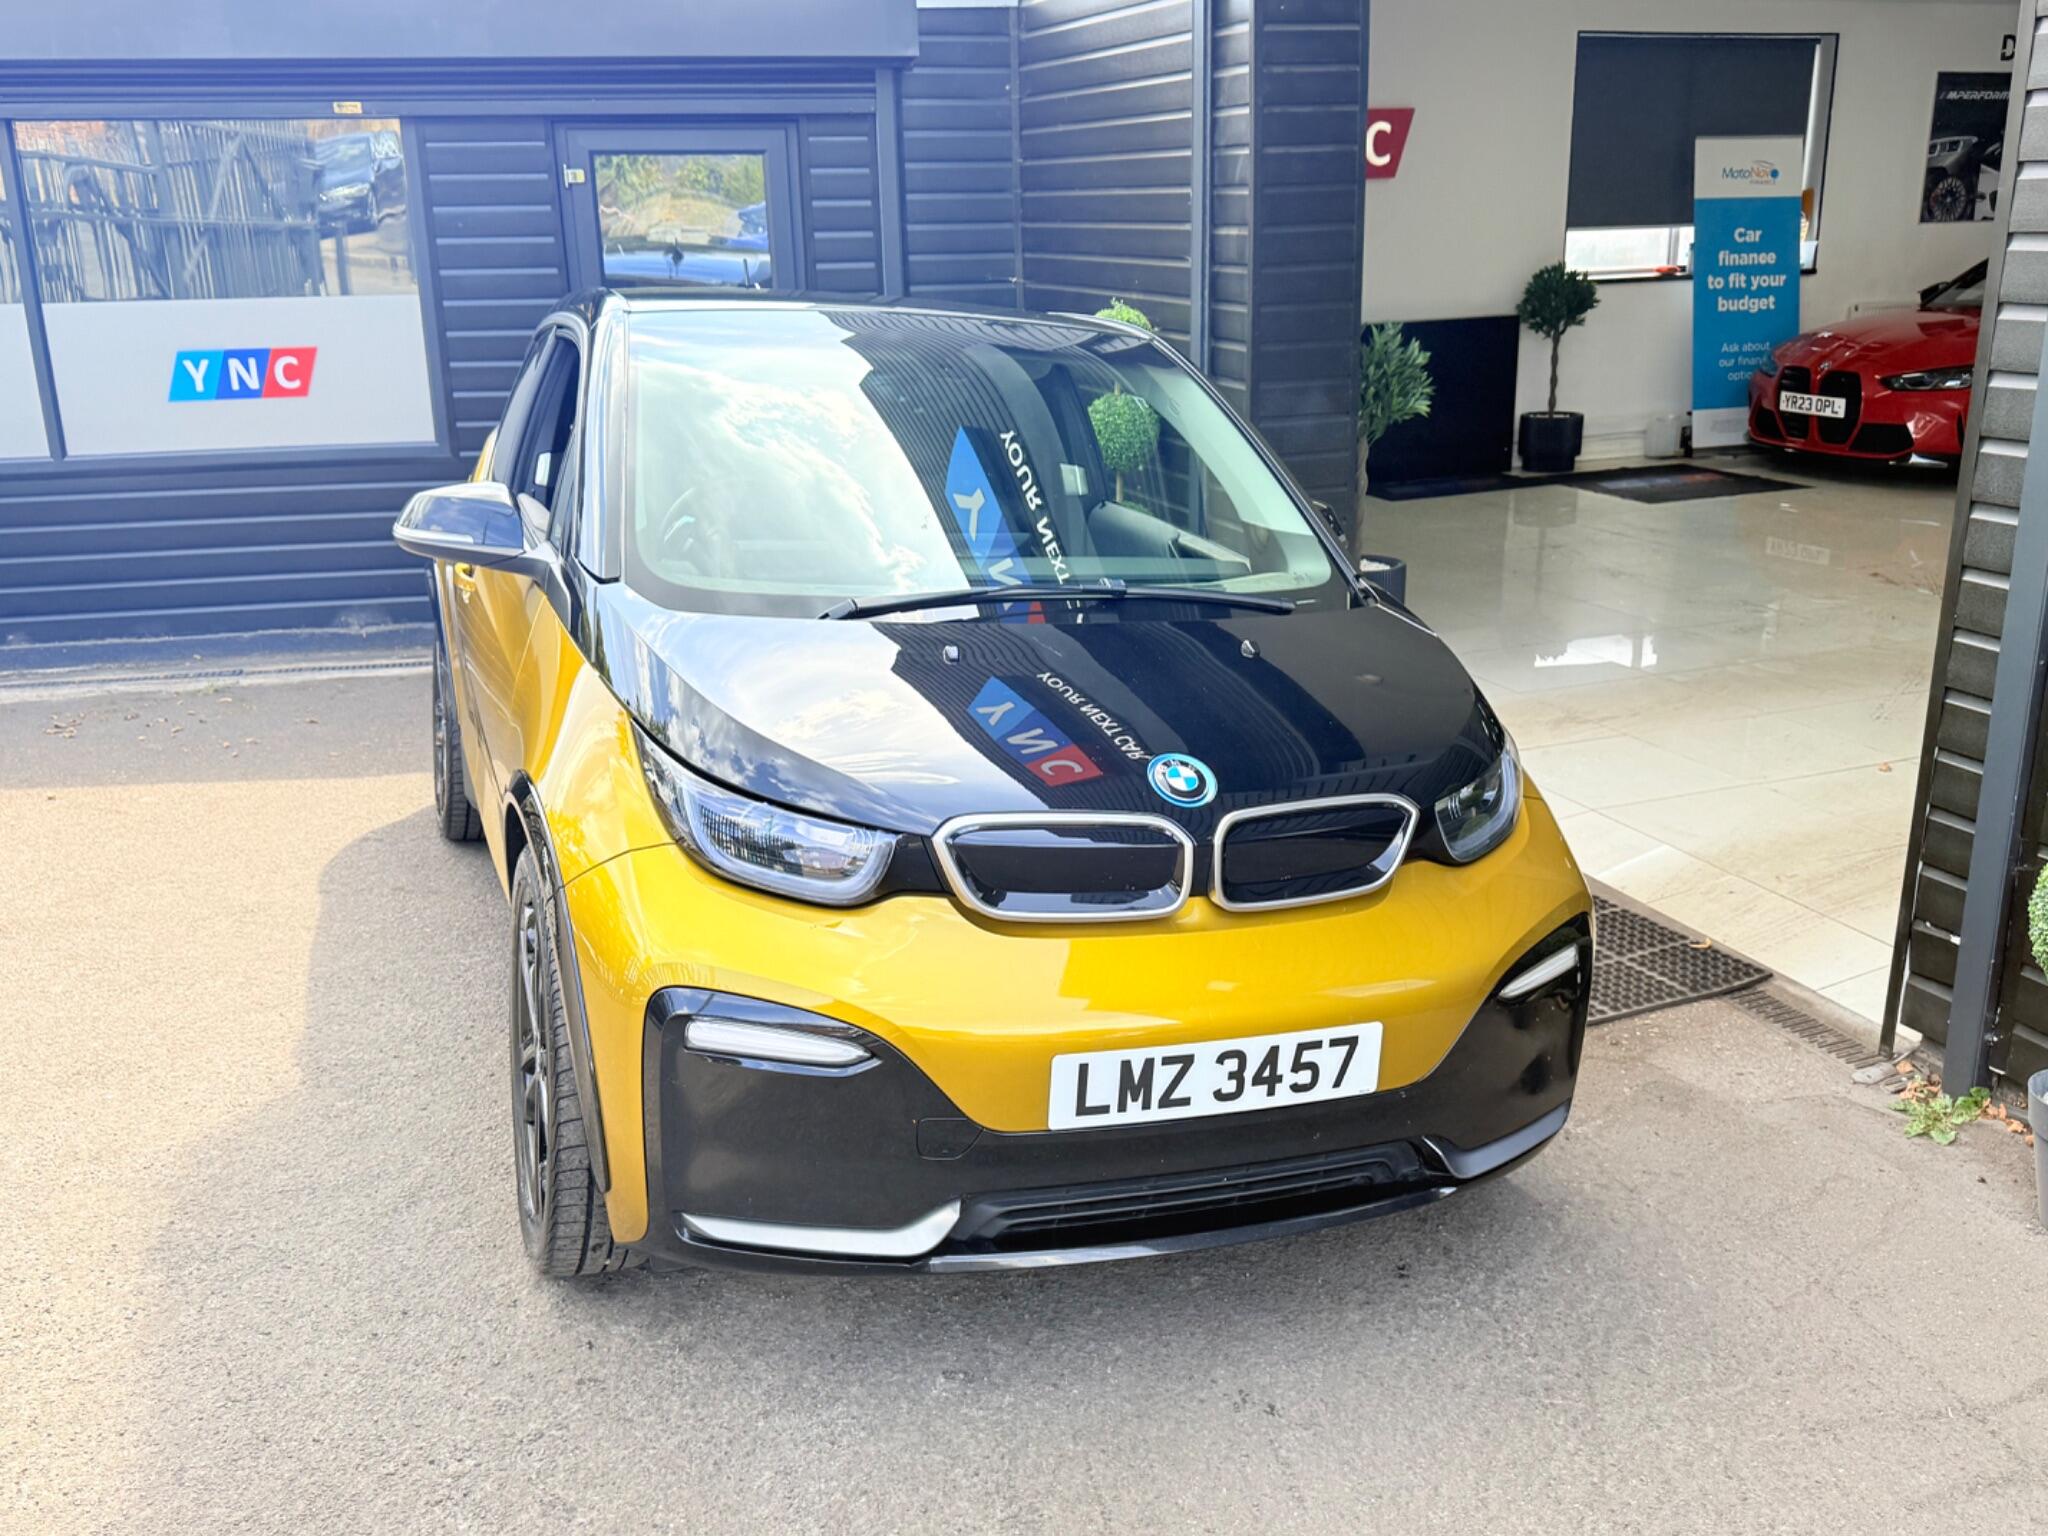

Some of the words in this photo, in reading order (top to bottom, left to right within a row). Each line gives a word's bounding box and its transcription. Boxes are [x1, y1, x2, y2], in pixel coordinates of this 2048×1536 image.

[1366, 121, 1392, 167] C
[1733, 227, 1763, 243] Car
[1718, 250, 1777, 267] finance
[1707, 274, 1724, 290] to
[1728, 272, 1747, 289] fit
[1750, 274, 1787, 291] your
[1717, 295, 1776, 314] budget
[1721, 342, 1740, 353] Ask
[1742, 341, 1771, 352] about
[1718, 359, 1735, 368] our
[182, 355, 301, 393] YNC
[1784, 394, 1813, 412] YR23
[1815, 398, 1840, 415] OPL
[1075, 1053, 1196, 1117] LMZ
[1212, 1034, 1360, 1103] 3457
